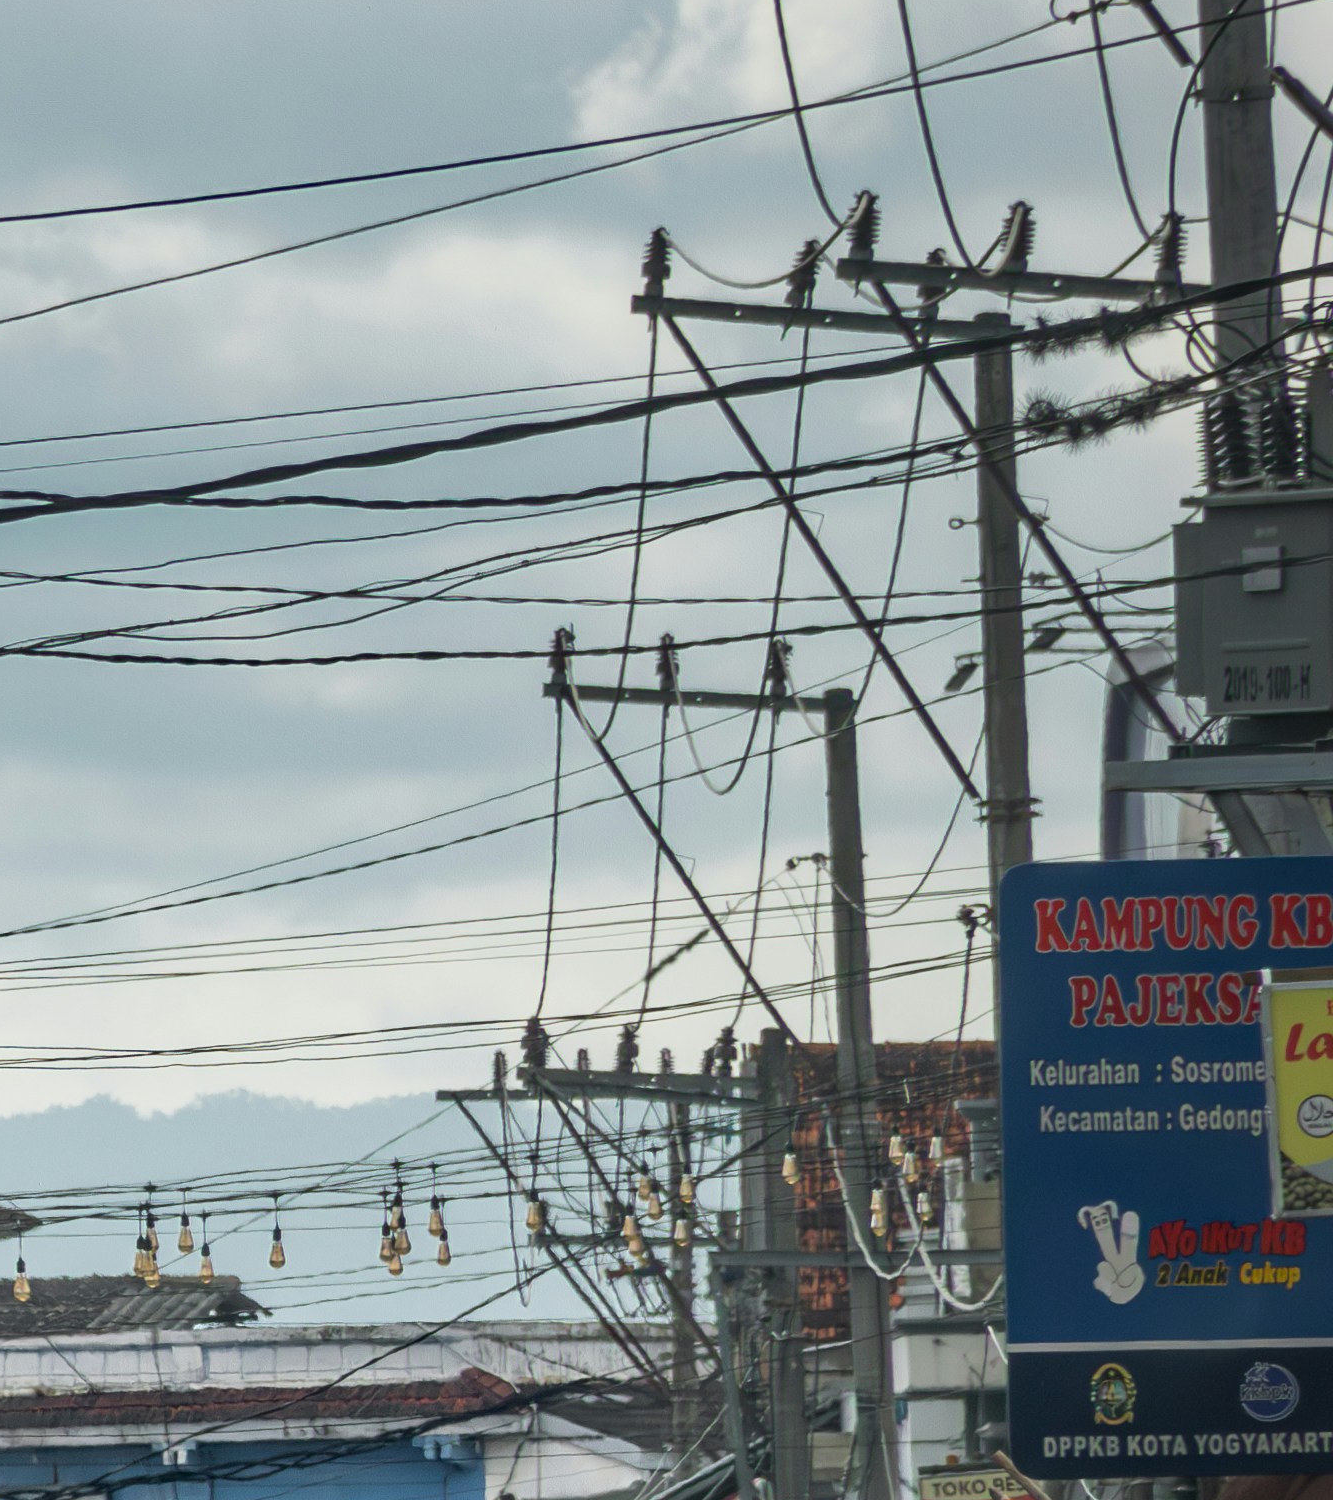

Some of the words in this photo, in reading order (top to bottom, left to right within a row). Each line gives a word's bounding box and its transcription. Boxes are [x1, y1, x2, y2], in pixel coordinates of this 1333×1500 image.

[1034, 894, 1259, 953] KAMPUNG
[1269, 893, 1333, 949] KB
[1030, 1058, 1140, 1087] Kelurahan
[1040, 1105, 1159, 1133] Kecamatan
[1155, 1261, 1172, 1287] 2
[1173, 1259, 1229, 1287] Anak
[1240, 1261, 1301, 1289] Cukup
[1044, 1434, 1120, 1459] DPPKB
[1127, 1433, 1188, 1457] KOTA
[932, 1479, 986, 1497] TOKO
